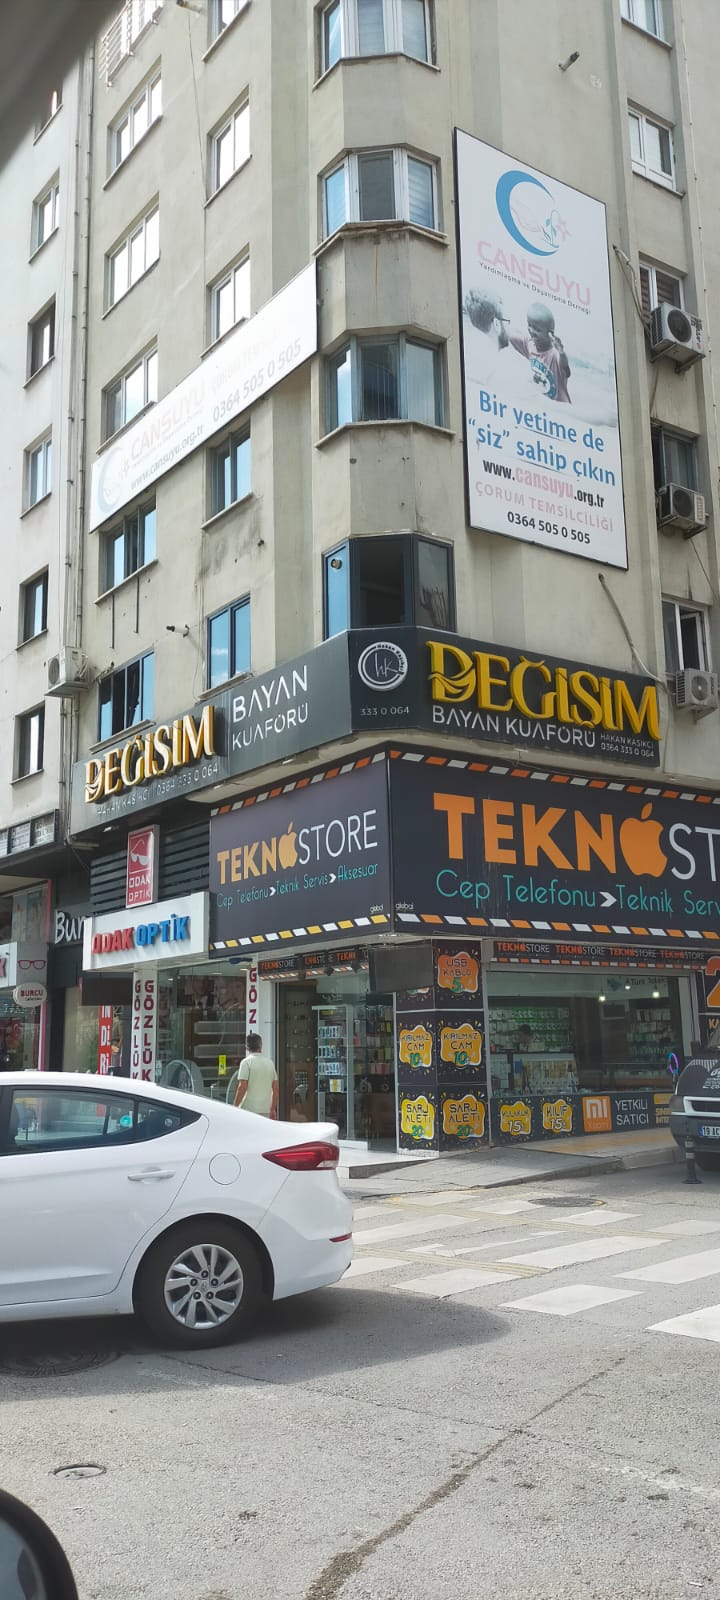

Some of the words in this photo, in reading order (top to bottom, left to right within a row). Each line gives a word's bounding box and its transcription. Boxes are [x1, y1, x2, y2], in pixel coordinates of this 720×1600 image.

[477, 240, 591, 306] CANSUYU
[212, 390, 242, 423] 0364
[243, 368, 266, 399] 505
[267, 360, 276, 379] 0
[278, 338, 303, 368] 505
[479, 390, 508, 418] Bir
[582, 428, 605, 452] de
[516, 440, 567, 471] sahip
[573, 457, 616, 487] çıkın
[475, 481, 526, 506] ÇORUM
[482, 459, 605, 509] www.cansuyu.org.tr
[507, 511, 536, 529] 0364
[538, 520, 559, 535] 505
[561, 526, 568, 538] 0
[570, 529, 591, 544] 505
[232, 665, 309, 724] BAYAN
[359, 707, 378, 716] 333
[380, 707, 388, 716] 0
[390, 706, 410, 715] 064
[232, 702, 309, 751] KUAFÖRÜ
[432, 705, 500, 734] BAYAN
[505, 716, 597, 748] KUAFÖRÜ
[600, 732, 626, 744] HAKAN
[600, 742, 619, 752] 0364
[620, 745, 633, 755] 333
[640, 749, 655, 758] 064
[201, 762, 219, 779] 064
[128, 874, 151, 888] ODAK
[216, 893, 233, 911] Cep
[236, 885, 270, 904] Telefonu
[275, 877, 300, 896] Teknik
[303, 873, 329, 889] Servis
[337, 863, 379, 881] Aksesuar
[435, 869, 490, 909] Cep
[502, 874, 597, 908] Telefonu
[616, 884, 675, 912] Teknik
[91, 927, 134, 954] ODAK
[136, 913, 191, 946] OPTİK
[446, 958, 468, 967] USB
[21, 990, 44, 998] BURCU
[248, 967, 258, 1034] GÖZ
[142, 980, 155, 1082] GÖZLÜK
[406, 1042, 425, 1051] CAM
[450, 1041, 473, 1050] CAM
[616, 1113, 649, 1126] SATICI
[703, 1127, 711, 1136] 19
